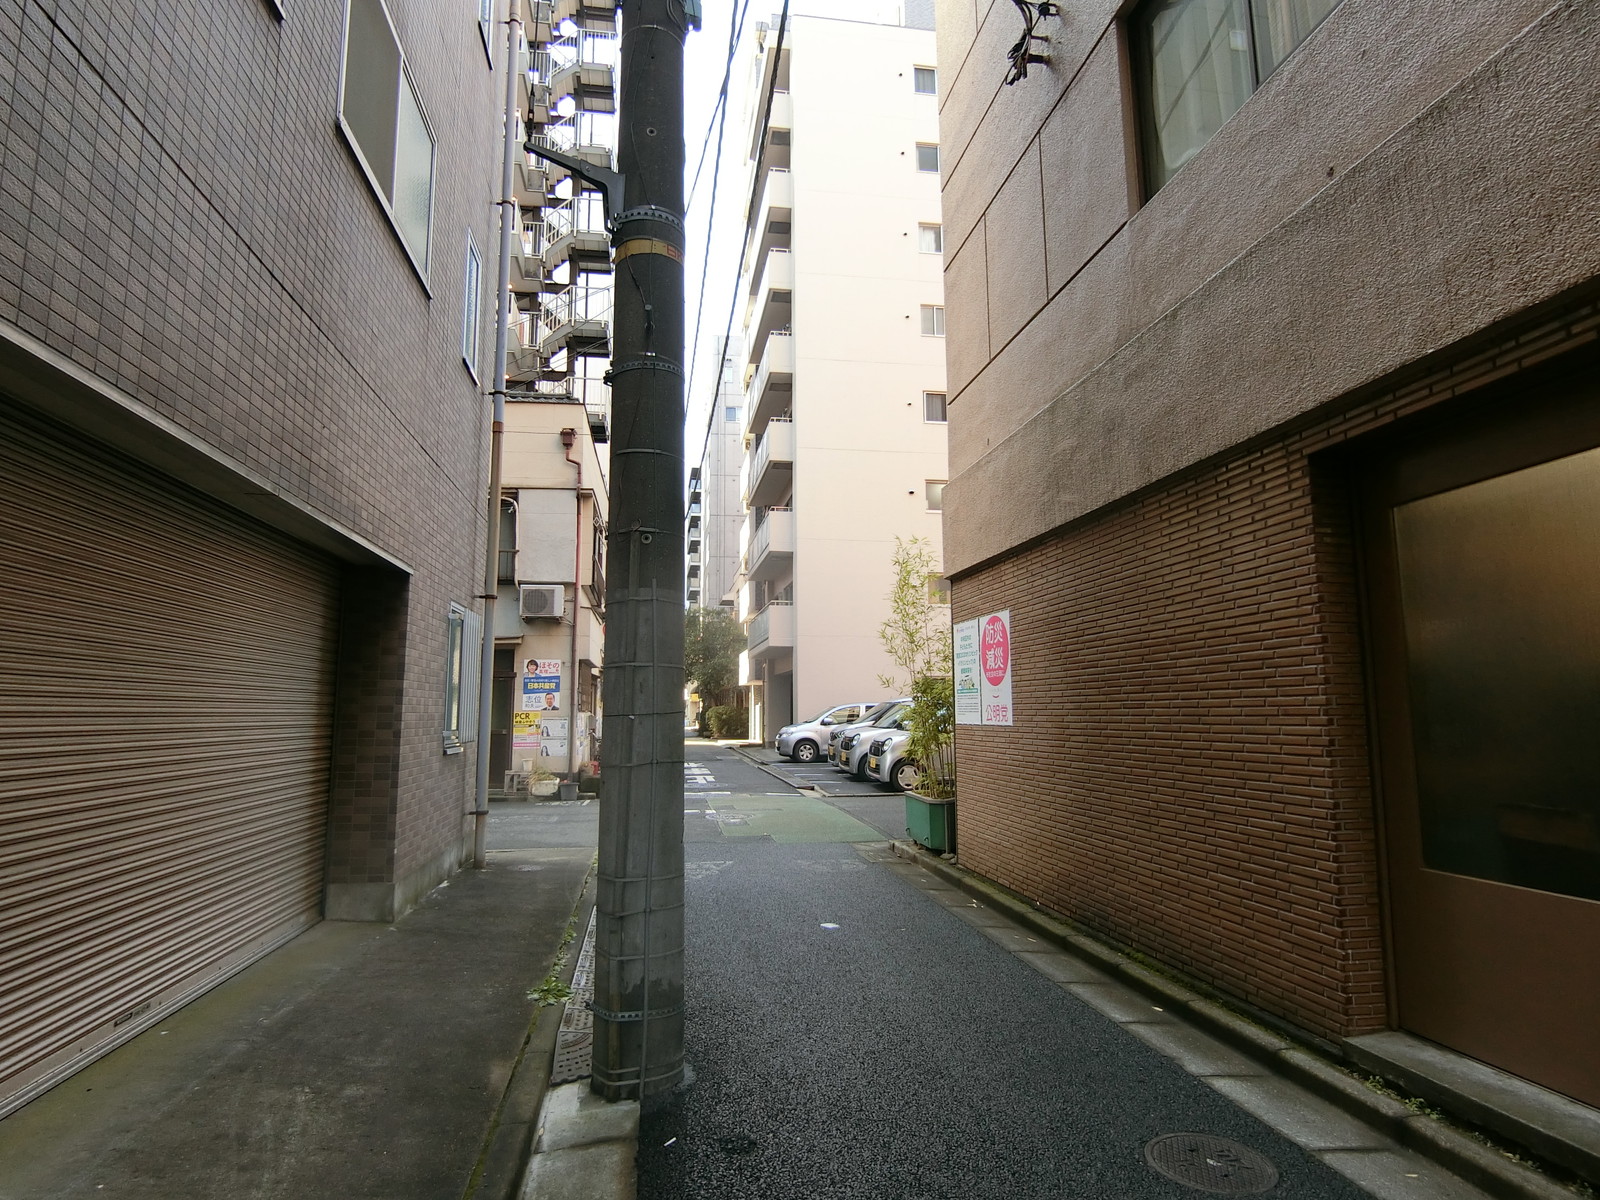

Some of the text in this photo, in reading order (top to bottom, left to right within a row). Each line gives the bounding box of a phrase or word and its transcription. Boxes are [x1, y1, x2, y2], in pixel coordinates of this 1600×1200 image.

[986, 621, 1004, 645] 防災
[986, 647, 1004, 669] 減災
[986, 704, 1009, 722] 公明党
